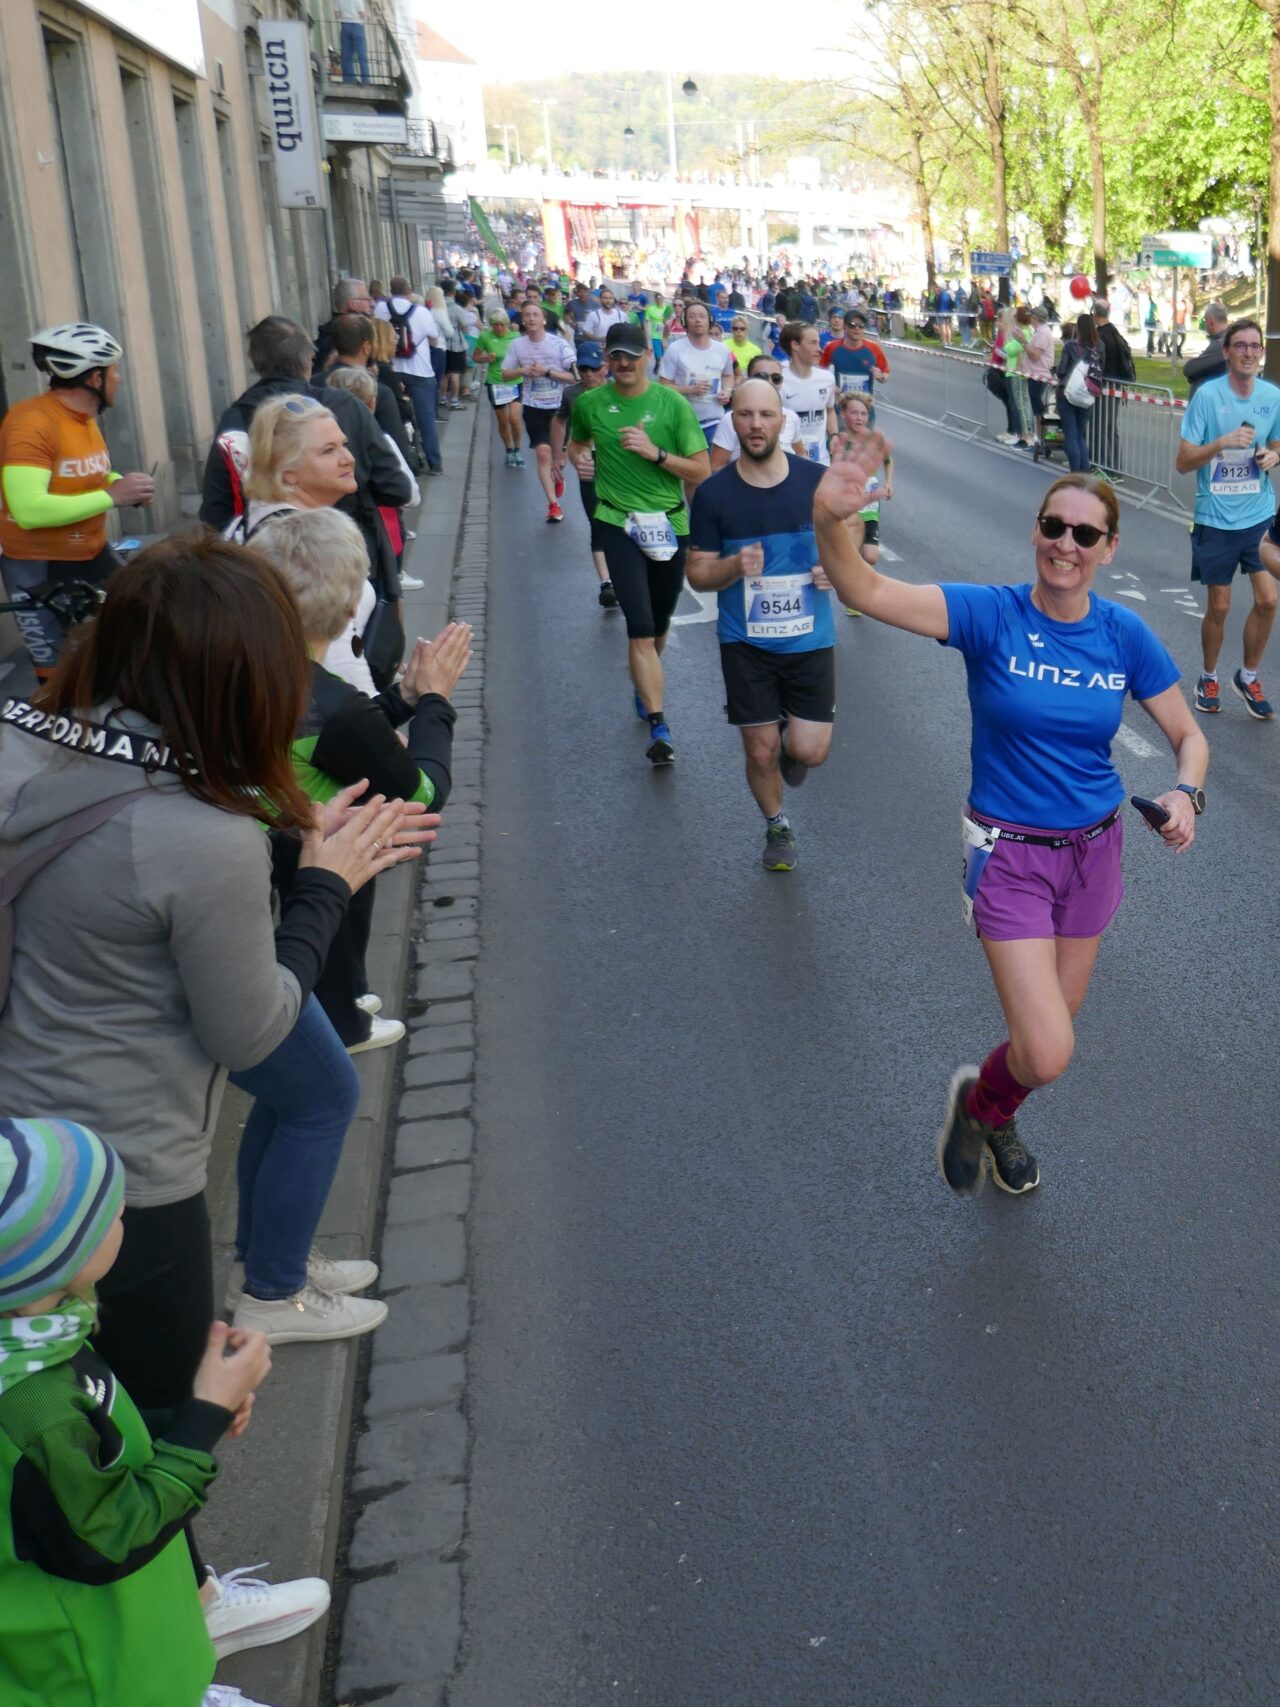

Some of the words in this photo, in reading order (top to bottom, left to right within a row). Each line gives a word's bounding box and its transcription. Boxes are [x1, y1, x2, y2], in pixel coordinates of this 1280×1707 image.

[265, 39, 303, 152] quitch
[1221, 466, 1250, 478] 9123
[632, 530, 672, 543] 10156
[760, 598, 802, 615] 9544
[792, 622, 810, 633] AG
[1087, 672, 1126, 690] AG
